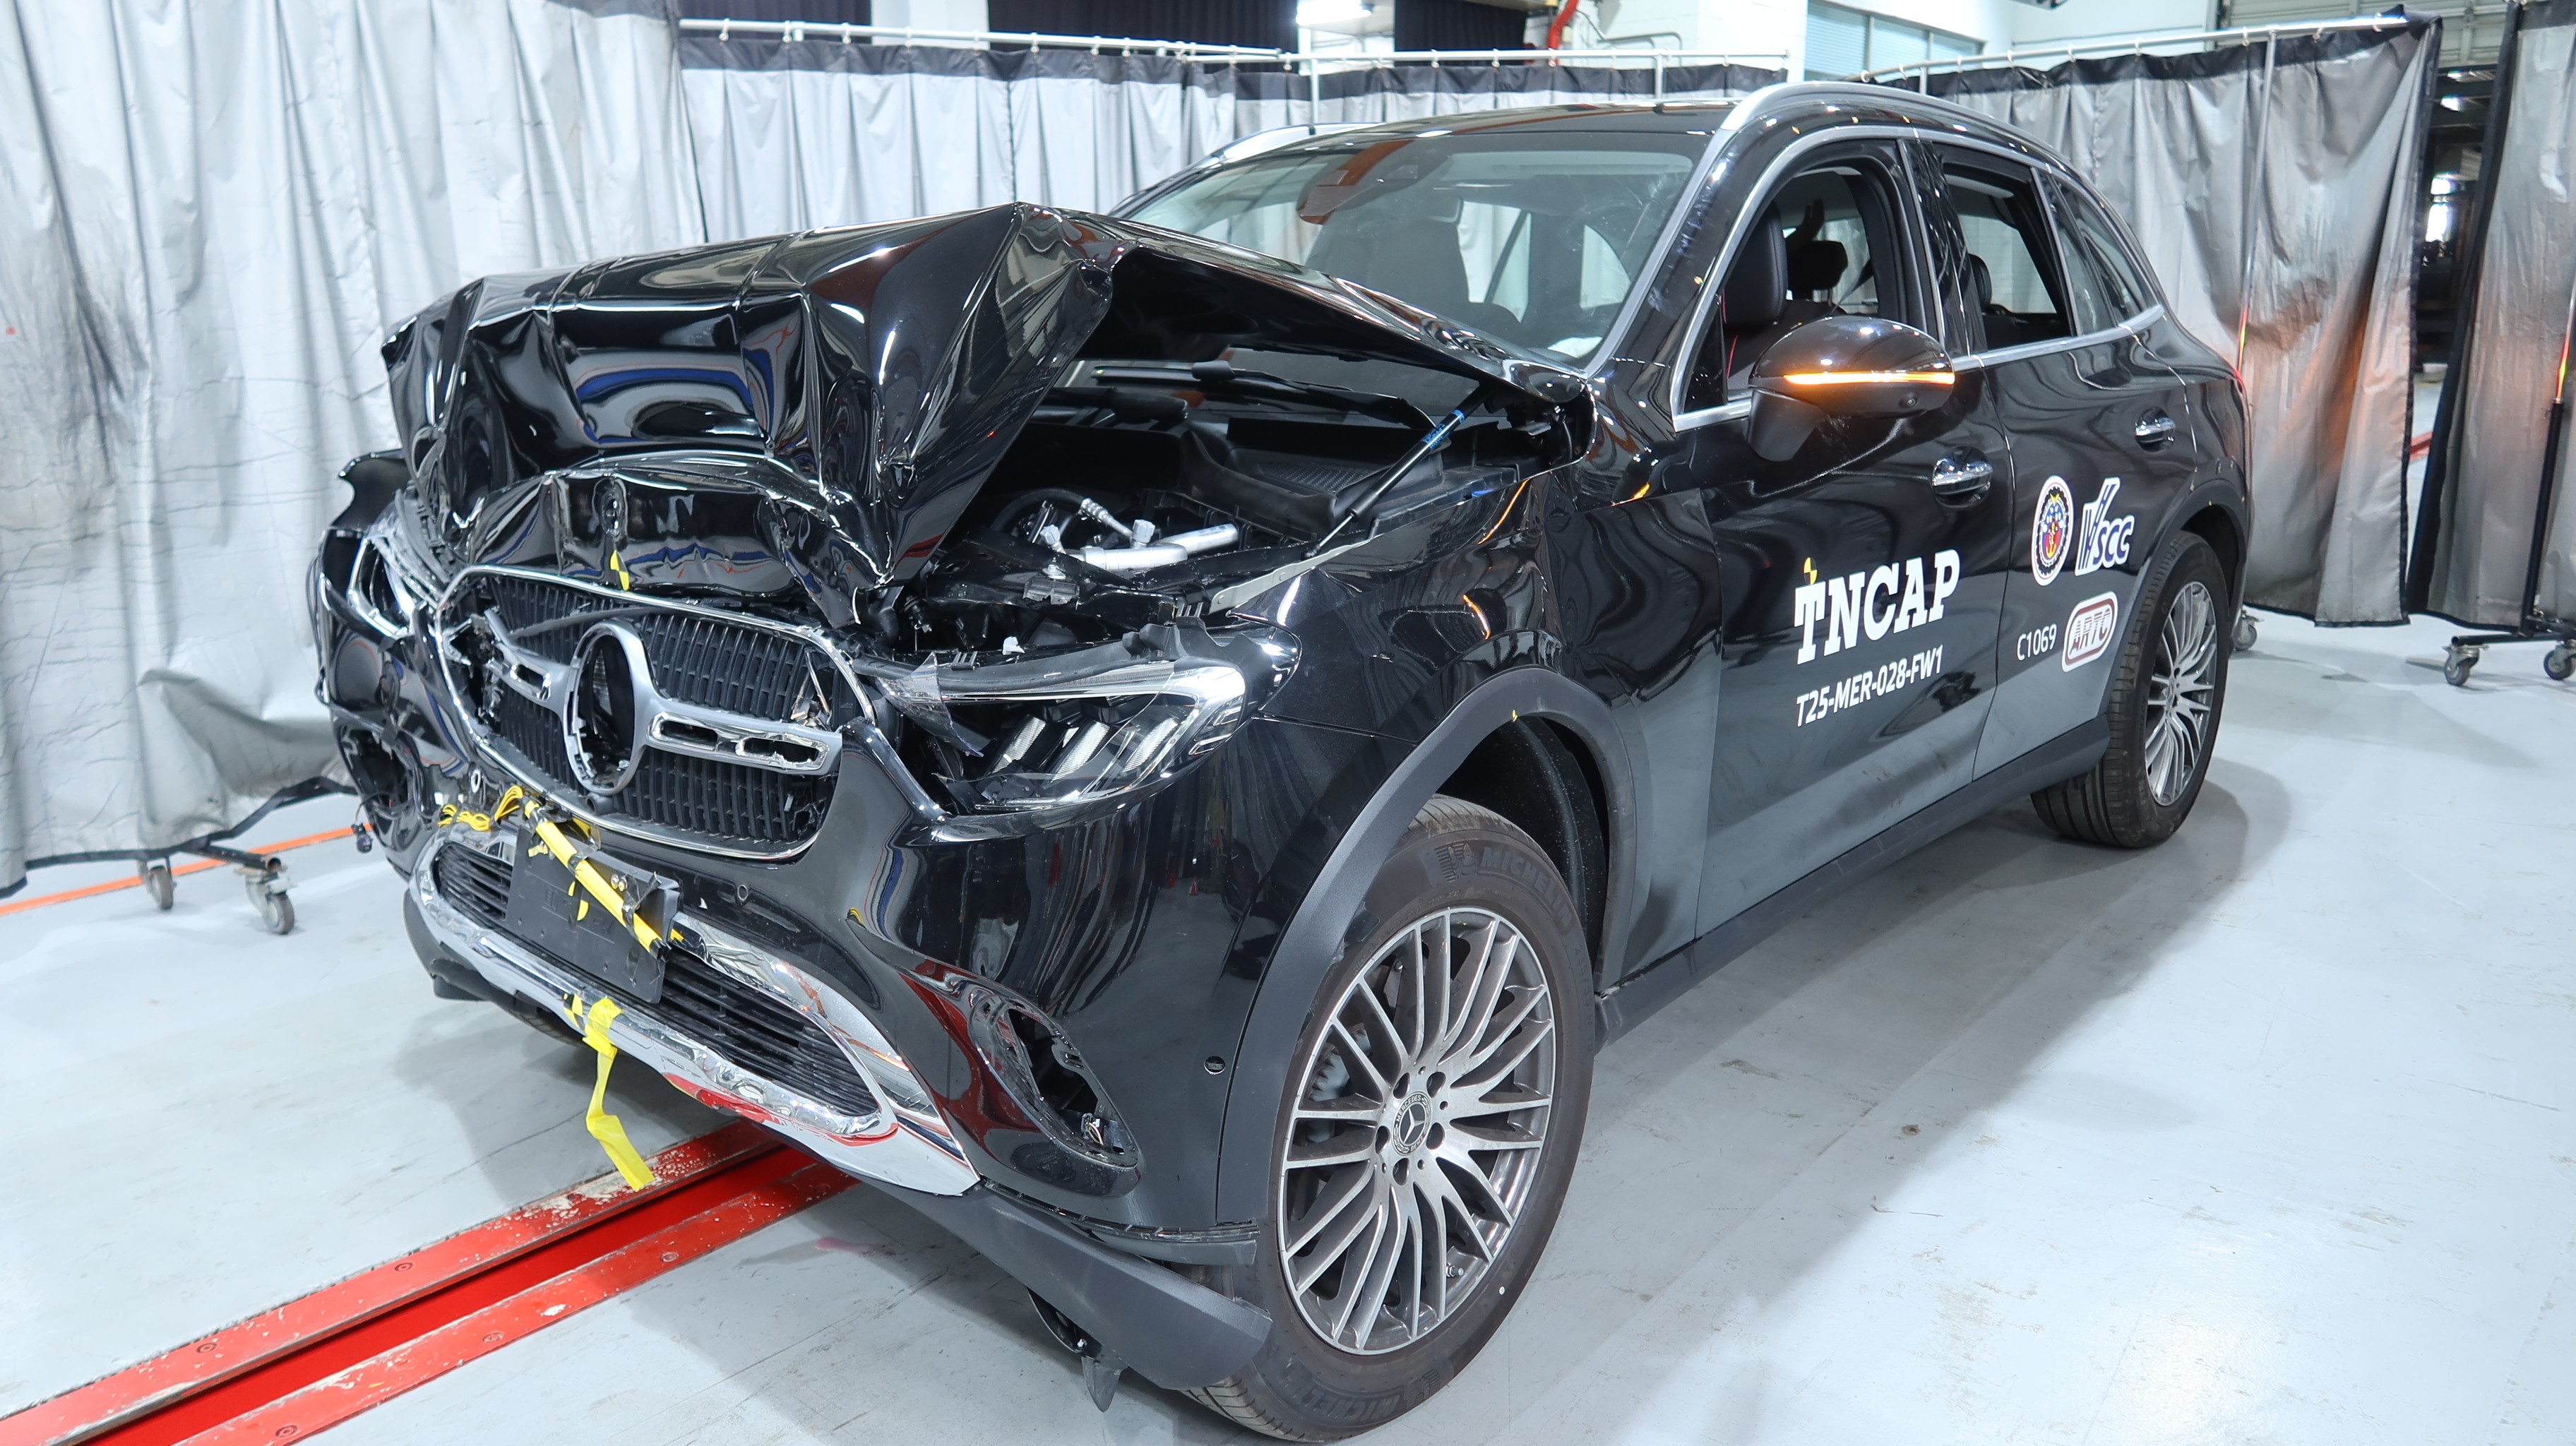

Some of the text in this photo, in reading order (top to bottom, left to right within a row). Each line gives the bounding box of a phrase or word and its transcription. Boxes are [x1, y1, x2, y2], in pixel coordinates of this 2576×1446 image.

[1794, 549, 1960, 665] TNCAP
[2070, 608, 2111, 657] ARTC
[2017, 623, 2058, 662] C1069
[1796, 644, 1943, 727] T25-MER-028-FW1
[1481, 847, 1573, 927] MICHELIN
[1396, 1094, 1421, 1123] MERCEDES
